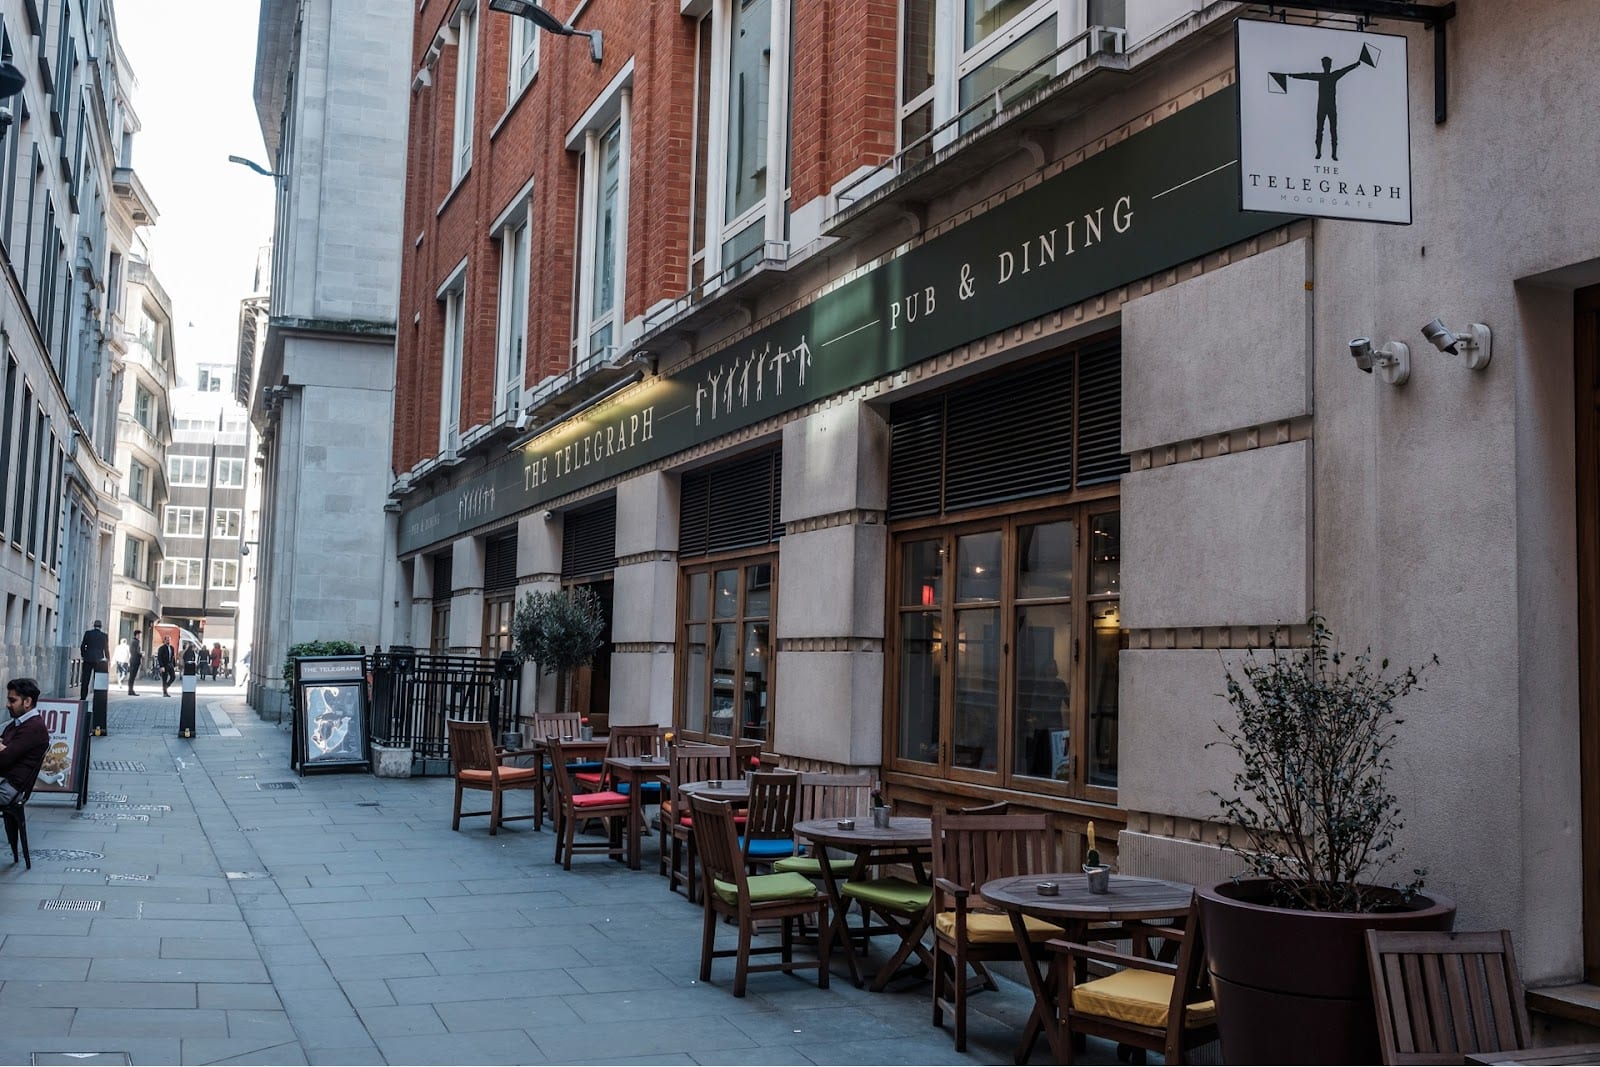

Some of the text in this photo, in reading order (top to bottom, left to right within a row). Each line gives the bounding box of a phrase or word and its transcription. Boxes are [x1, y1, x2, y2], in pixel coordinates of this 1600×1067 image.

[1314, 165, 1339, 175] THE
[1249, 174, 1401, 199] TELEGRAPH
[1281, 194, 1373, 208] MOORGATE
[890, 195, 1134, 330] PUB & DINING
[524, 406, 655, 491] THE TELEGRAPH
[320, 665, 360, 673] TELEGRAPH
[51, 746, 68, 755] NEW
